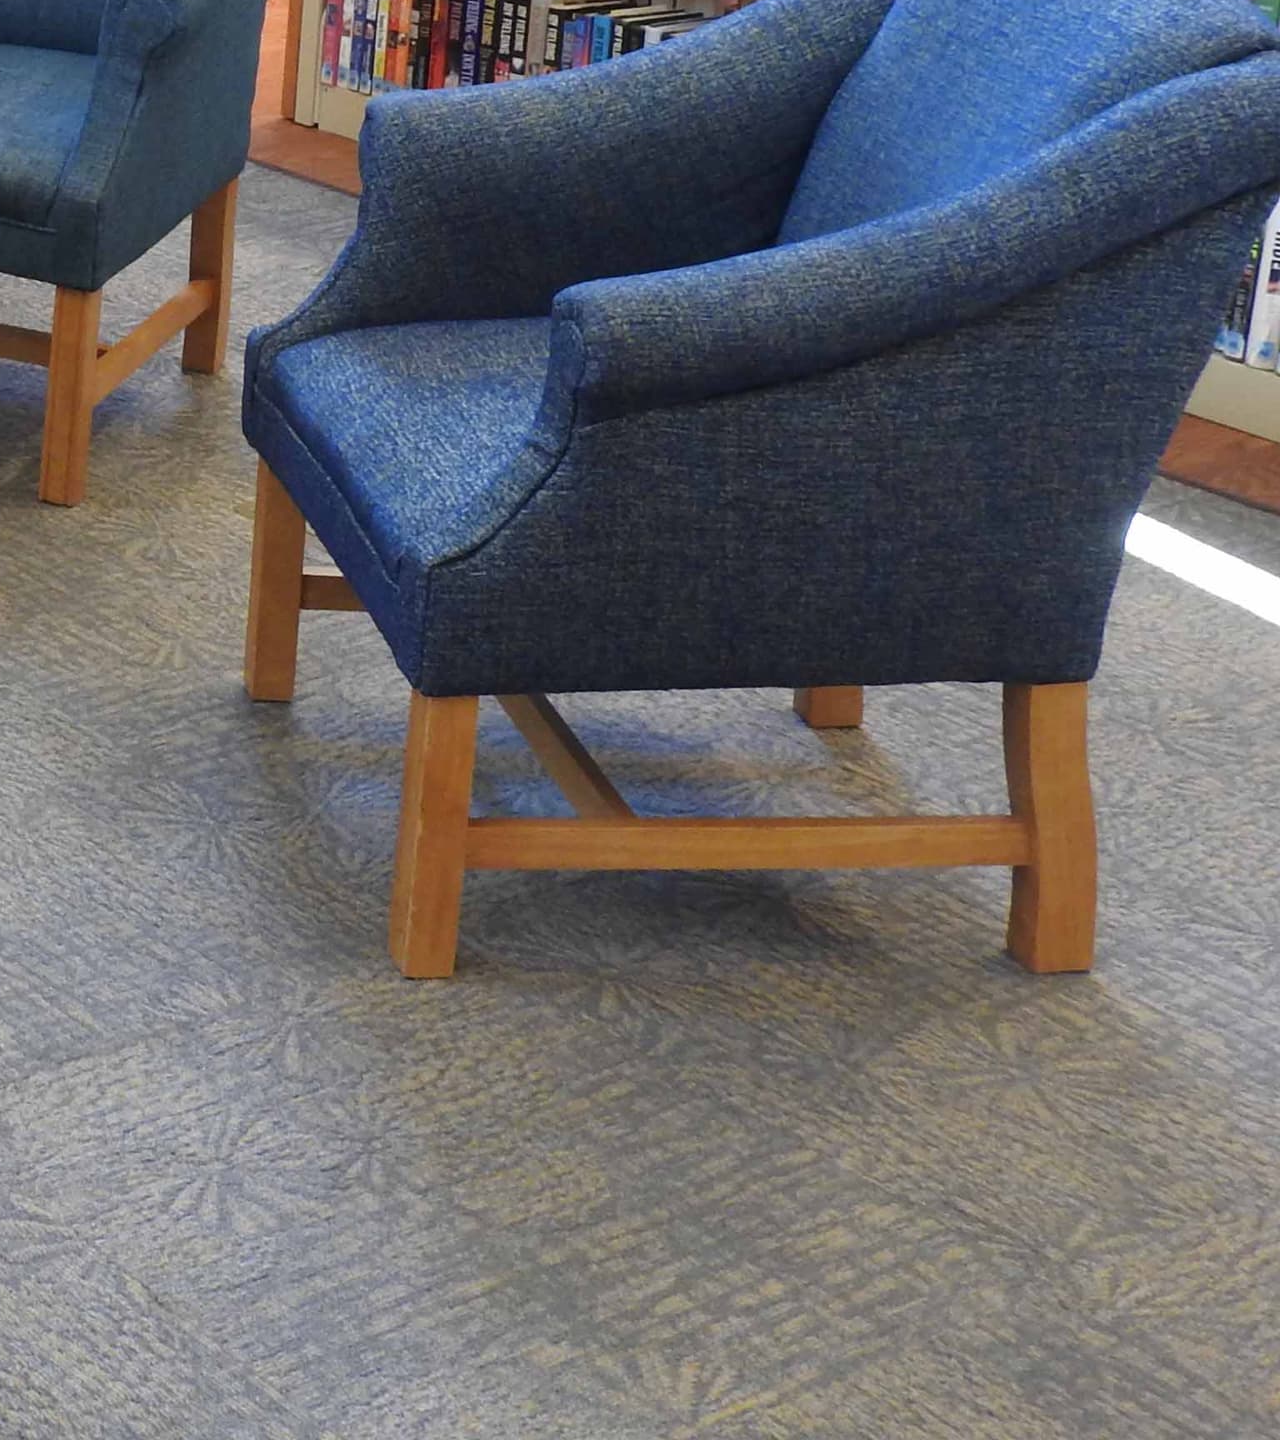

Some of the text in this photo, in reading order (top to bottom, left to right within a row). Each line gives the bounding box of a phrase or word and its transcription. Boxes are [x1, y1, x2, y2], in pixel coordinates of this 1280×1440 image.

[462, 1, 479, 76] FIELDING DON'T
[481, 9, 494, 46] FIELDING
[500, 2, 512, 54] JOY FIELDING
[514, 20, 526, 52] FIELDING
[545, 28, 557, 61] FIELDING
[615, 25, 623, 37] JOY
